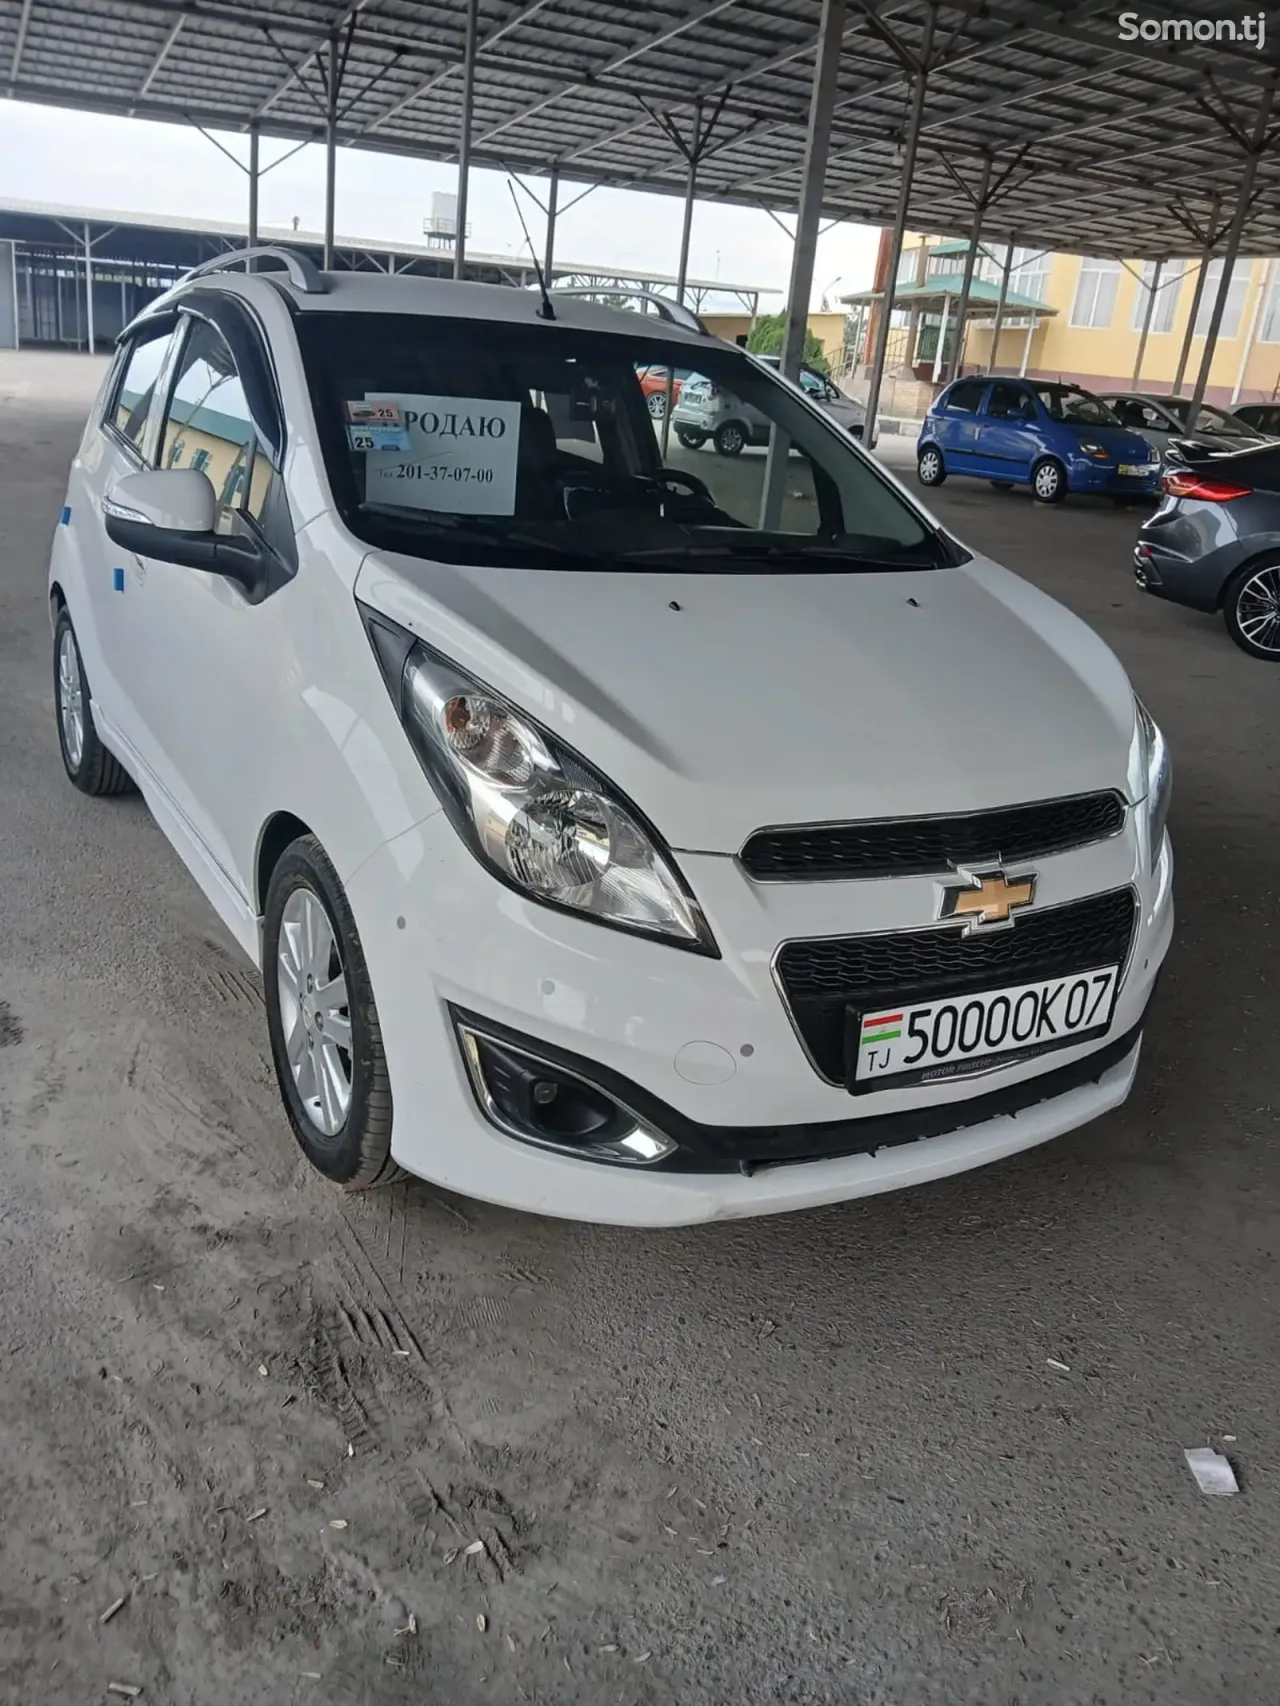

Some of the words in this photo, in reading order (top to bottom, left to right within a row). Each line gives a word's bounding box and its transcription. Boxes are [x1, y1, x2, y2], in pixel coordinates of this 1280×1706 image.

[377, 408, 394, 418] 25
[383, 410, 507, 440] РОДАЮ
[354, 436, 375, 449] 25
[396, 464, 494, 483] 201-37-07-00
[867, 1048, 891, 1072] TJ
[920, 1065, 956, 1080] MOTOR
